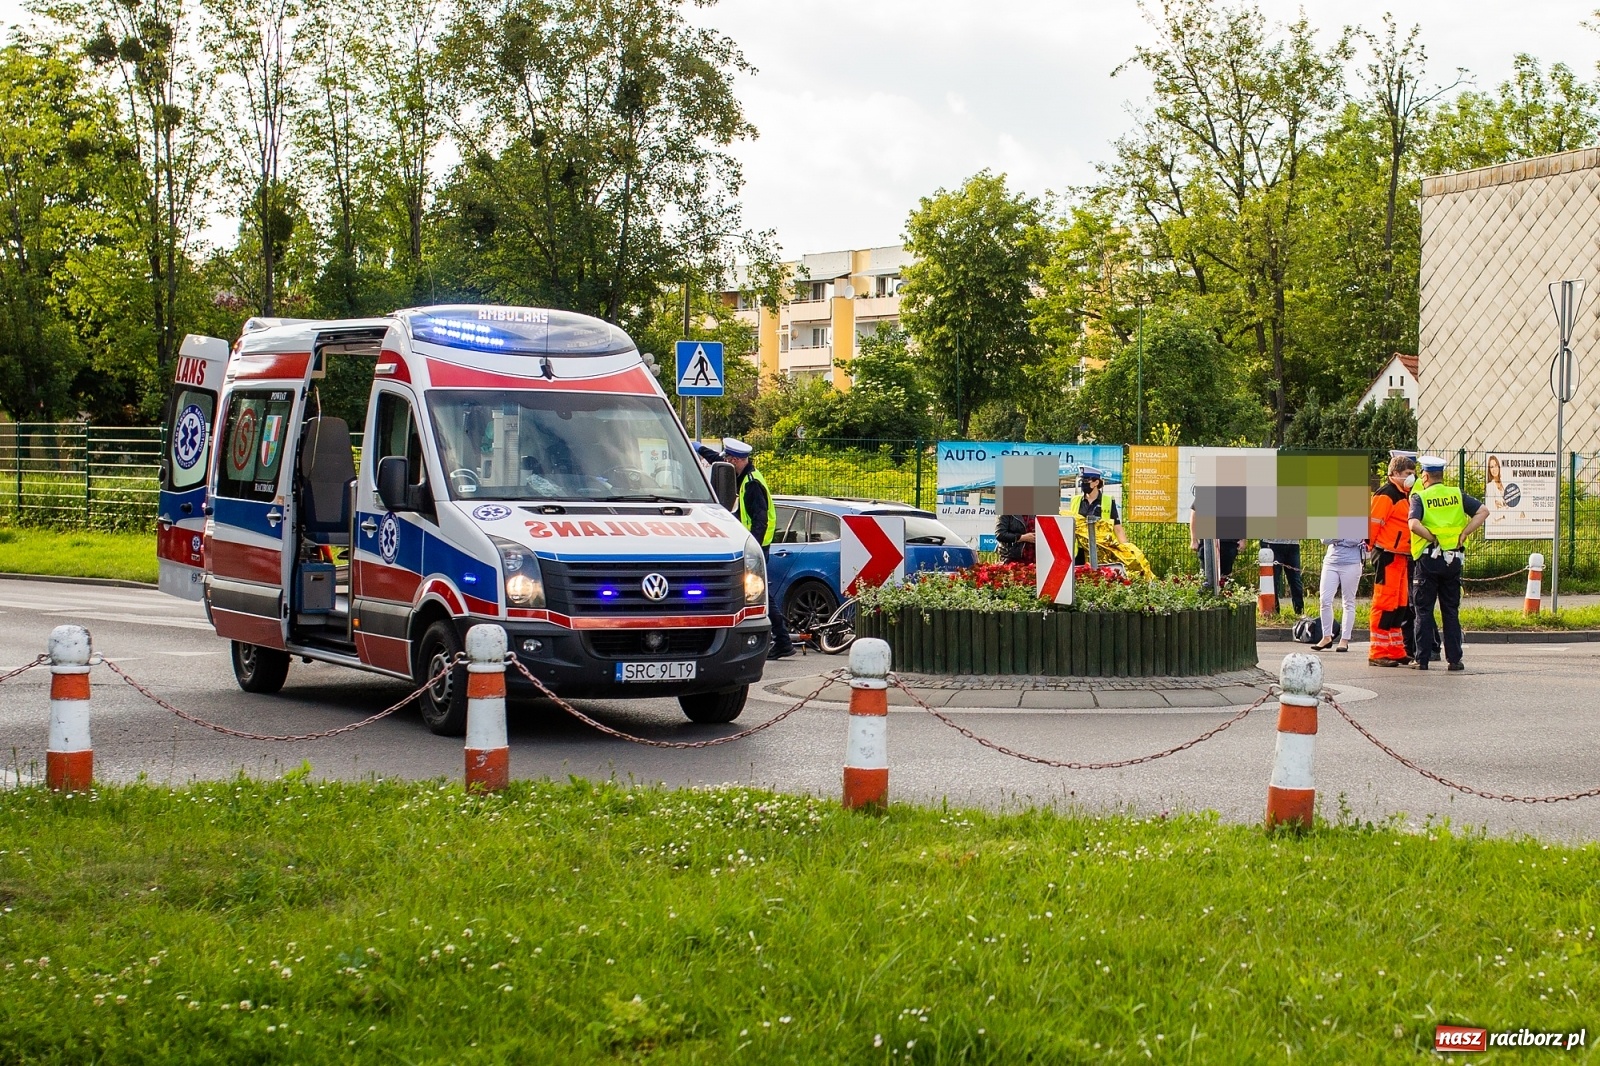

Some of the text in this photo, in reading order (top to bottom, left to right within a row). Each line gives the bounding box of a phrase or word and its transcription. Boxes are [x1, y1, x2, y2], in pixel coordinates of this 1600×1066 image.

[478, 309, 549, 323] AMBULANS
[175, 356, 207, 386] LANS
[944, 449, 987, 461] AUTO
[1426, 495, 1459, 509] POLICJA
[942, 507, 952, 515] ul.
[955, 507, 976, 515] Jana
[625, 663, 656, 679] SRC
[660, 662, 694, 678] 9LT9
